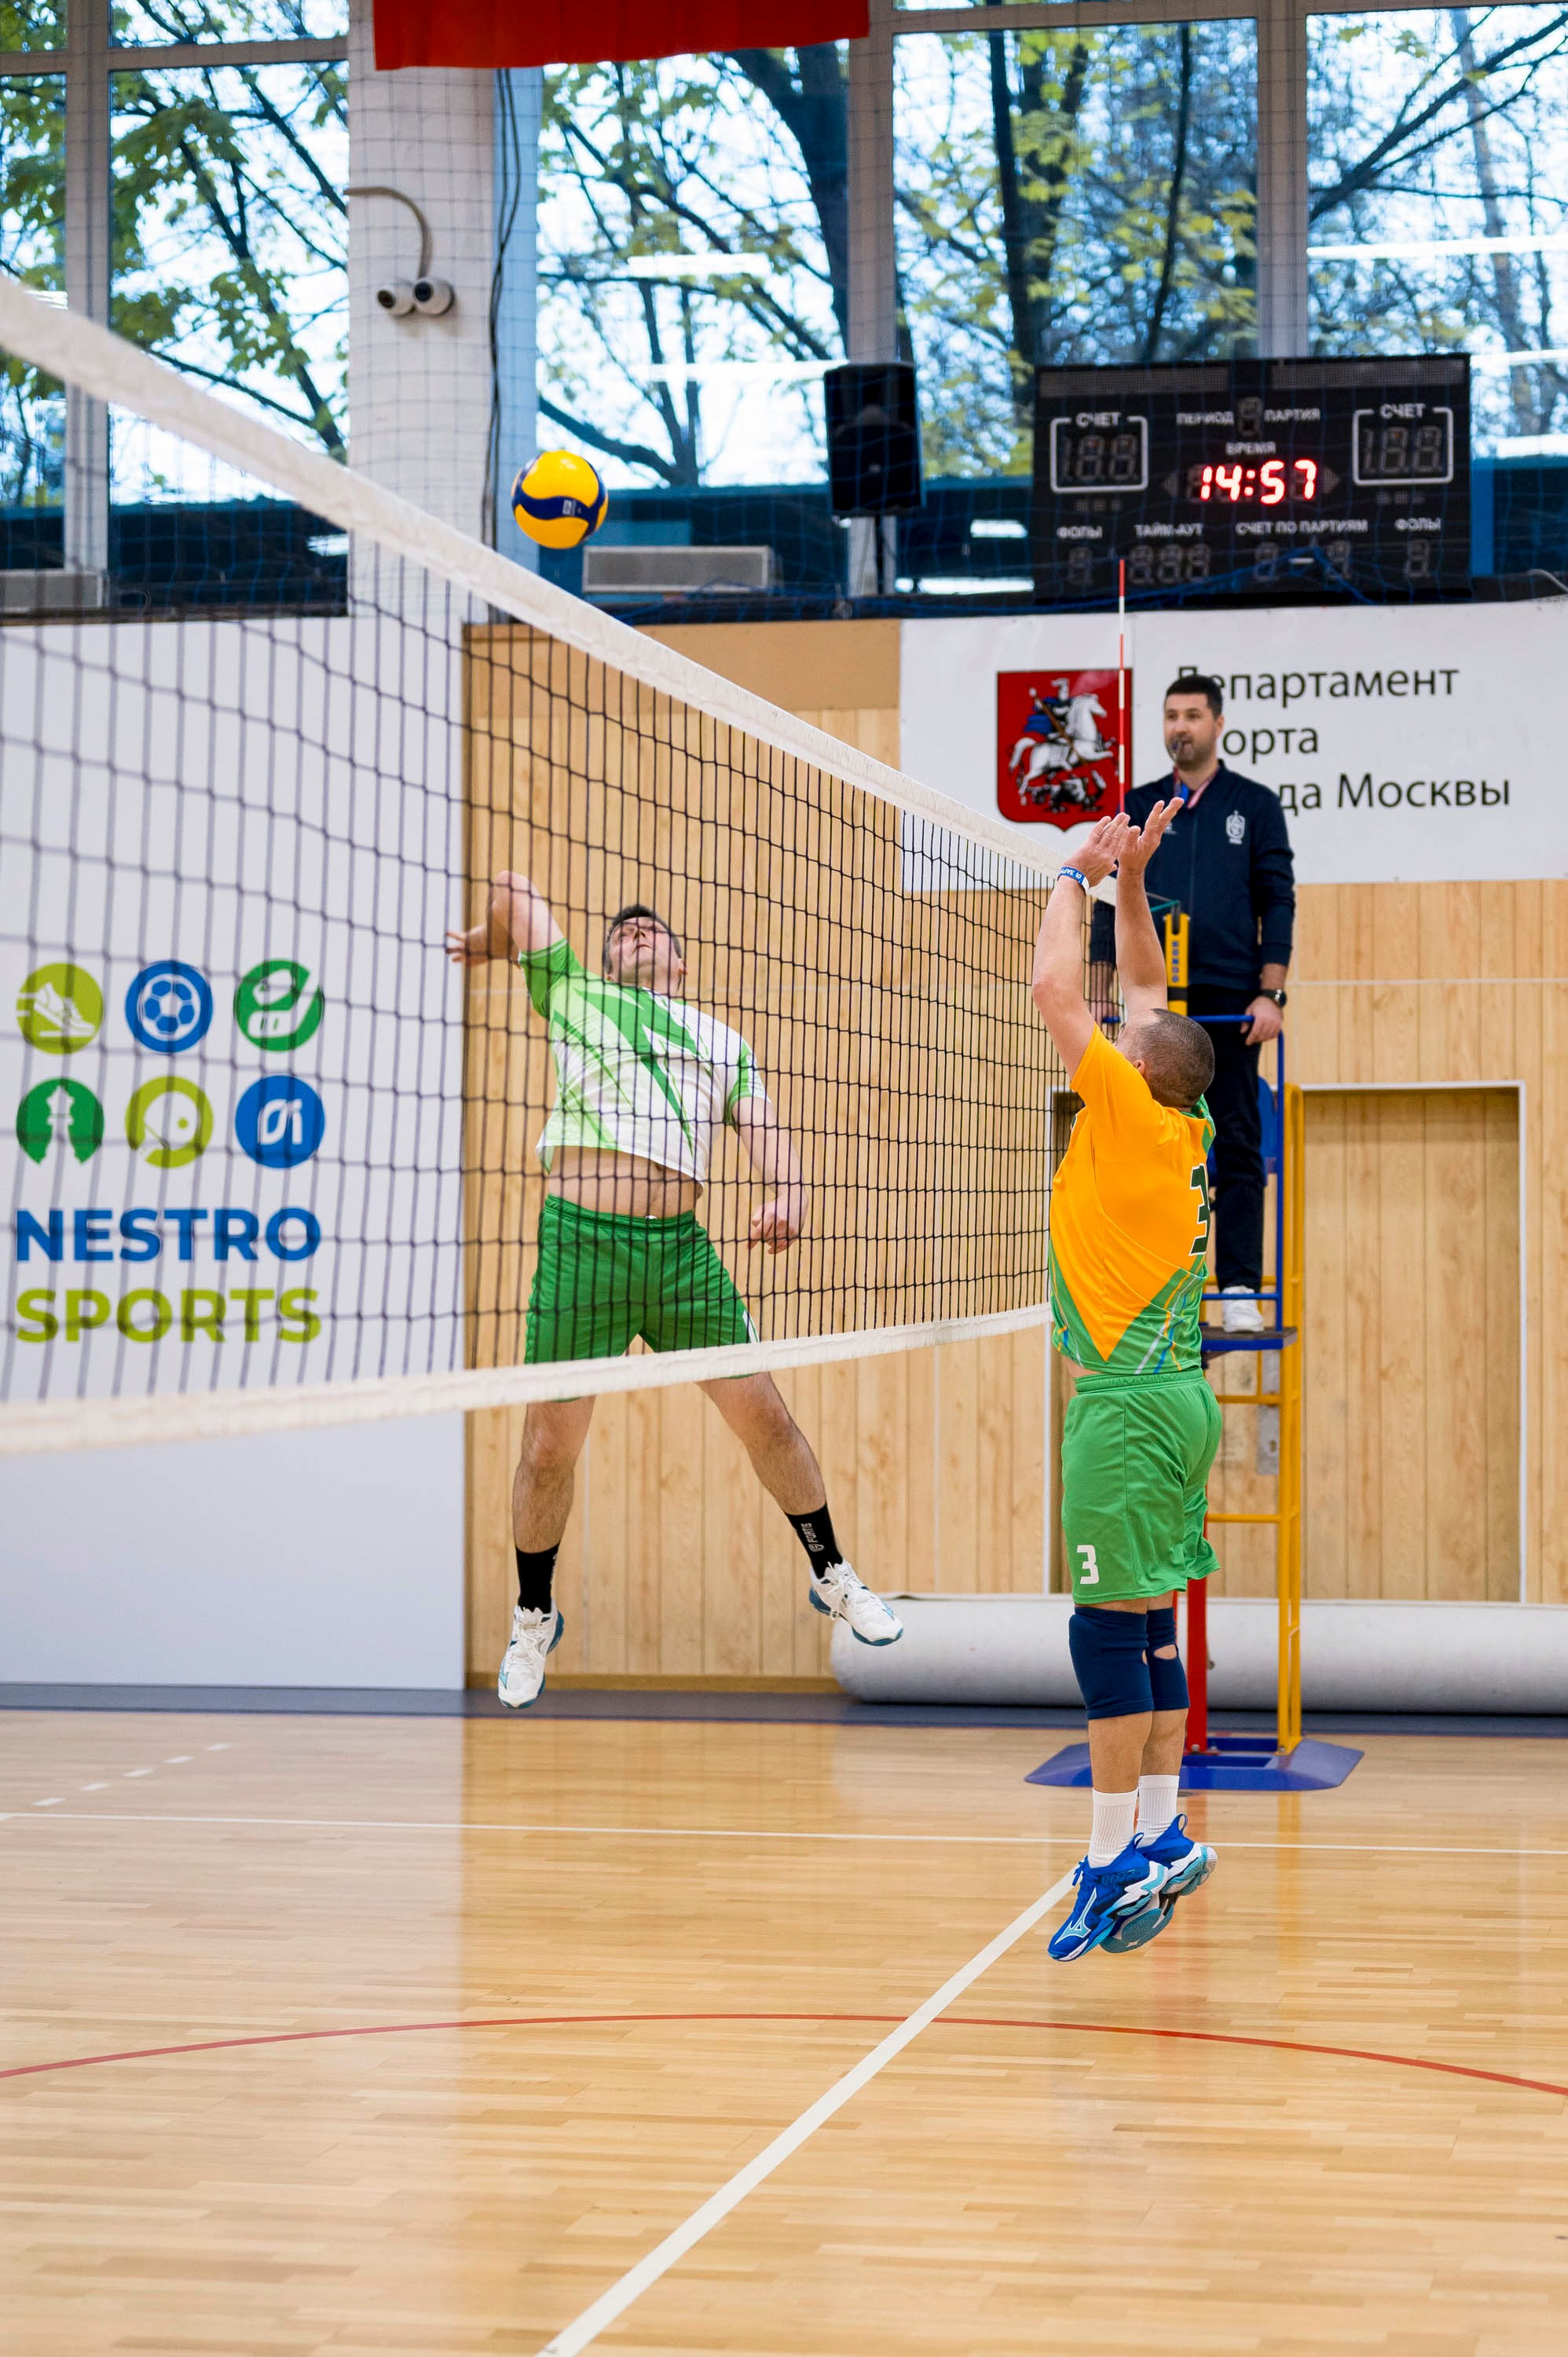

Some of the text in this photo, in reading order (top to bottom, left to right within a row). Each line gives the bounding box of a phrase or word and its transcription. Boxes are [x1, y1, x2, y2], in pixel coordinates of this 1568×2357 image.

[1075, 412, 1122, 428] СЧЕТ
[1176, 412, 1234, 426] ПЕРИОД
[1264, 408, 1321, 423] ПАРТИЯ
[1379, 402, 1427, 420] СЧЕТ
[1225, 442, 1277, 456] ВРЕМЯ
[1200, 459, 1317, 504] 14:57
[1235, 519, 1369, 536] СЧЕТ ПО ПАРТИЯМ
[1178, 666, 1460, 708] партамент
[1222, 727, 1320, 764] орта
[1338, 773, 1510, 809] Москвы
[16, 1208, 321, 1263] NESTRO
[16, 1288, 322, 1343] SPORTS
[1076, 1545, 1099, 1585] 3
